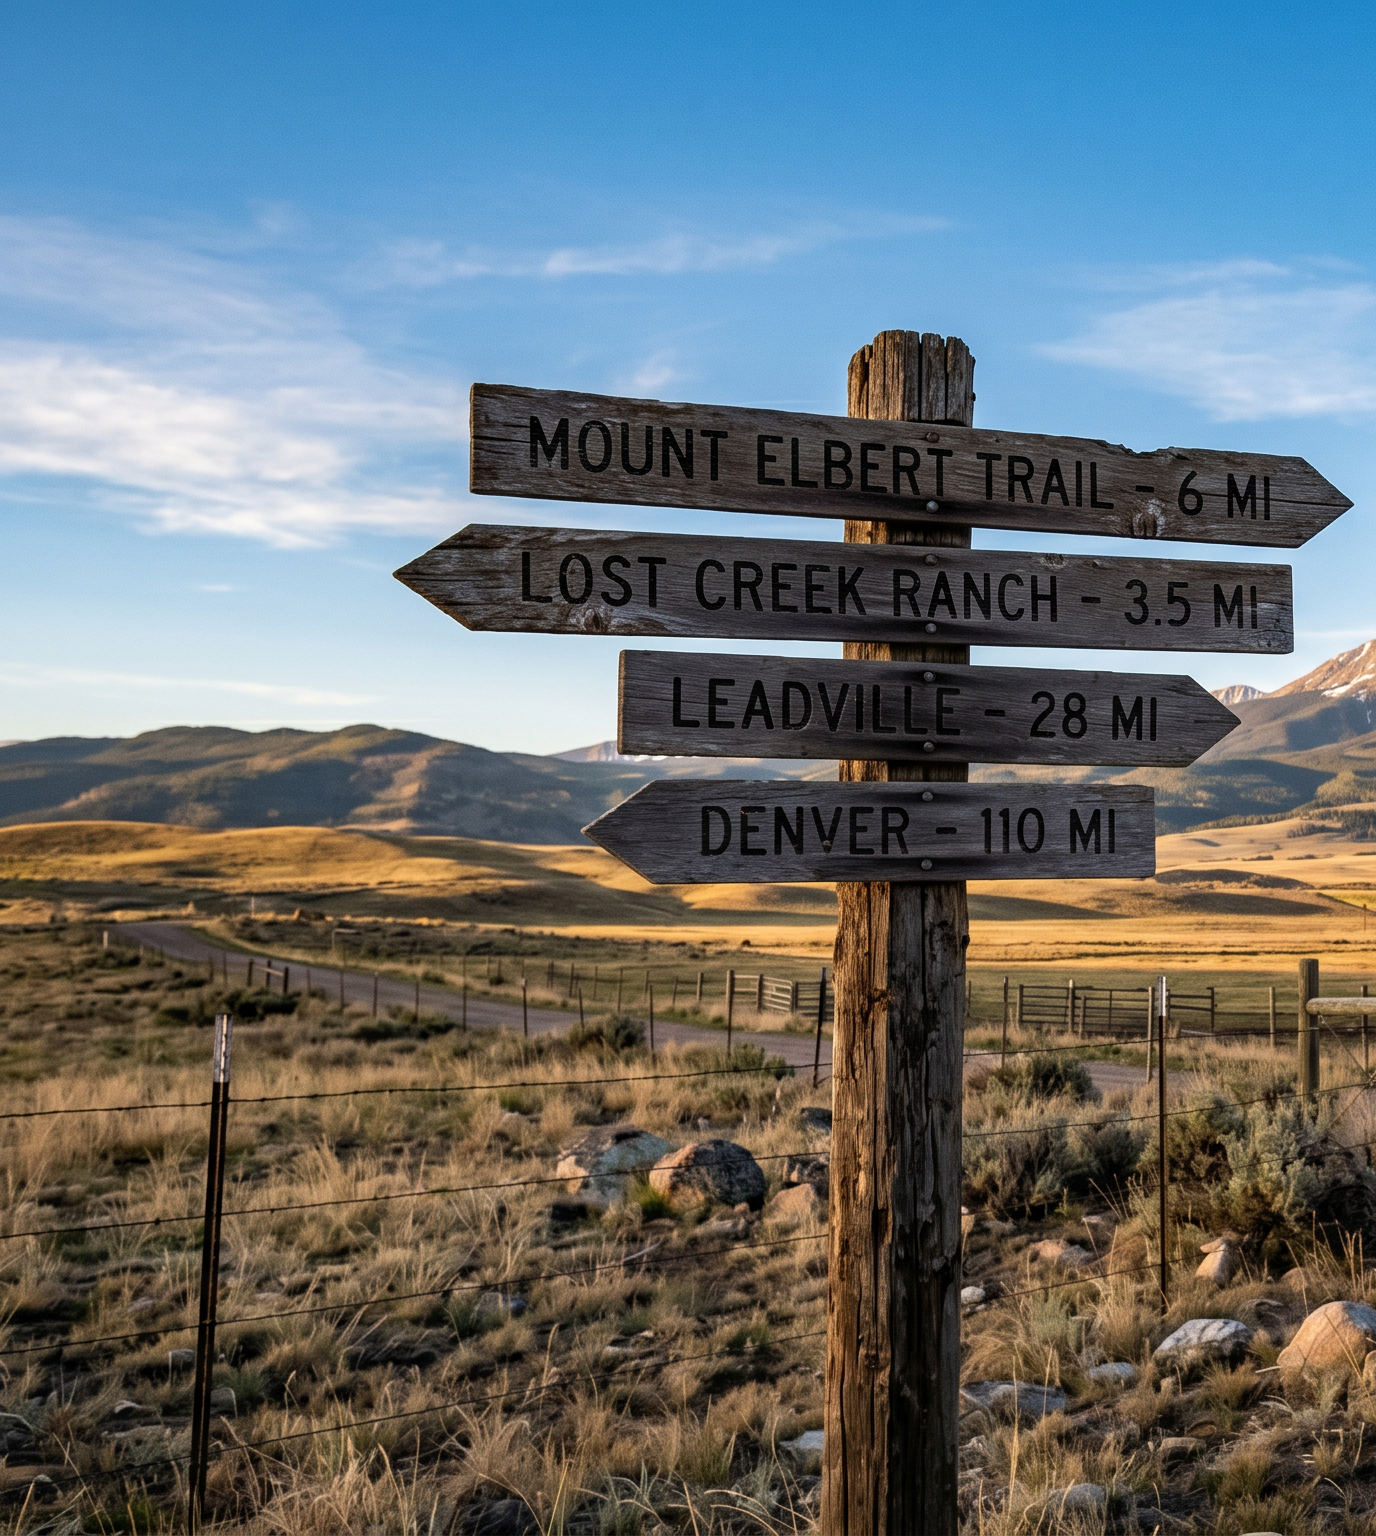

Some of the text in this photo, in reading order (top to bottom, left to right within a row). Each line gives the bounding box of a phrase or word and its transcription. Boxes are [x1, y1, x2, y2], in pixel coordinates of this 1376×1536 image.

[529, 416, 1270, 520] MOUNT ELBERT TRAIL - 6 MI
[521, 551, 1257, 629] LOST CREEK RANCH - 3.5 MI
[672, 677, 1157, 741] LEADVILLE - 28 MI
[701, 805, 1115, 856] DENVER - 110 MI
